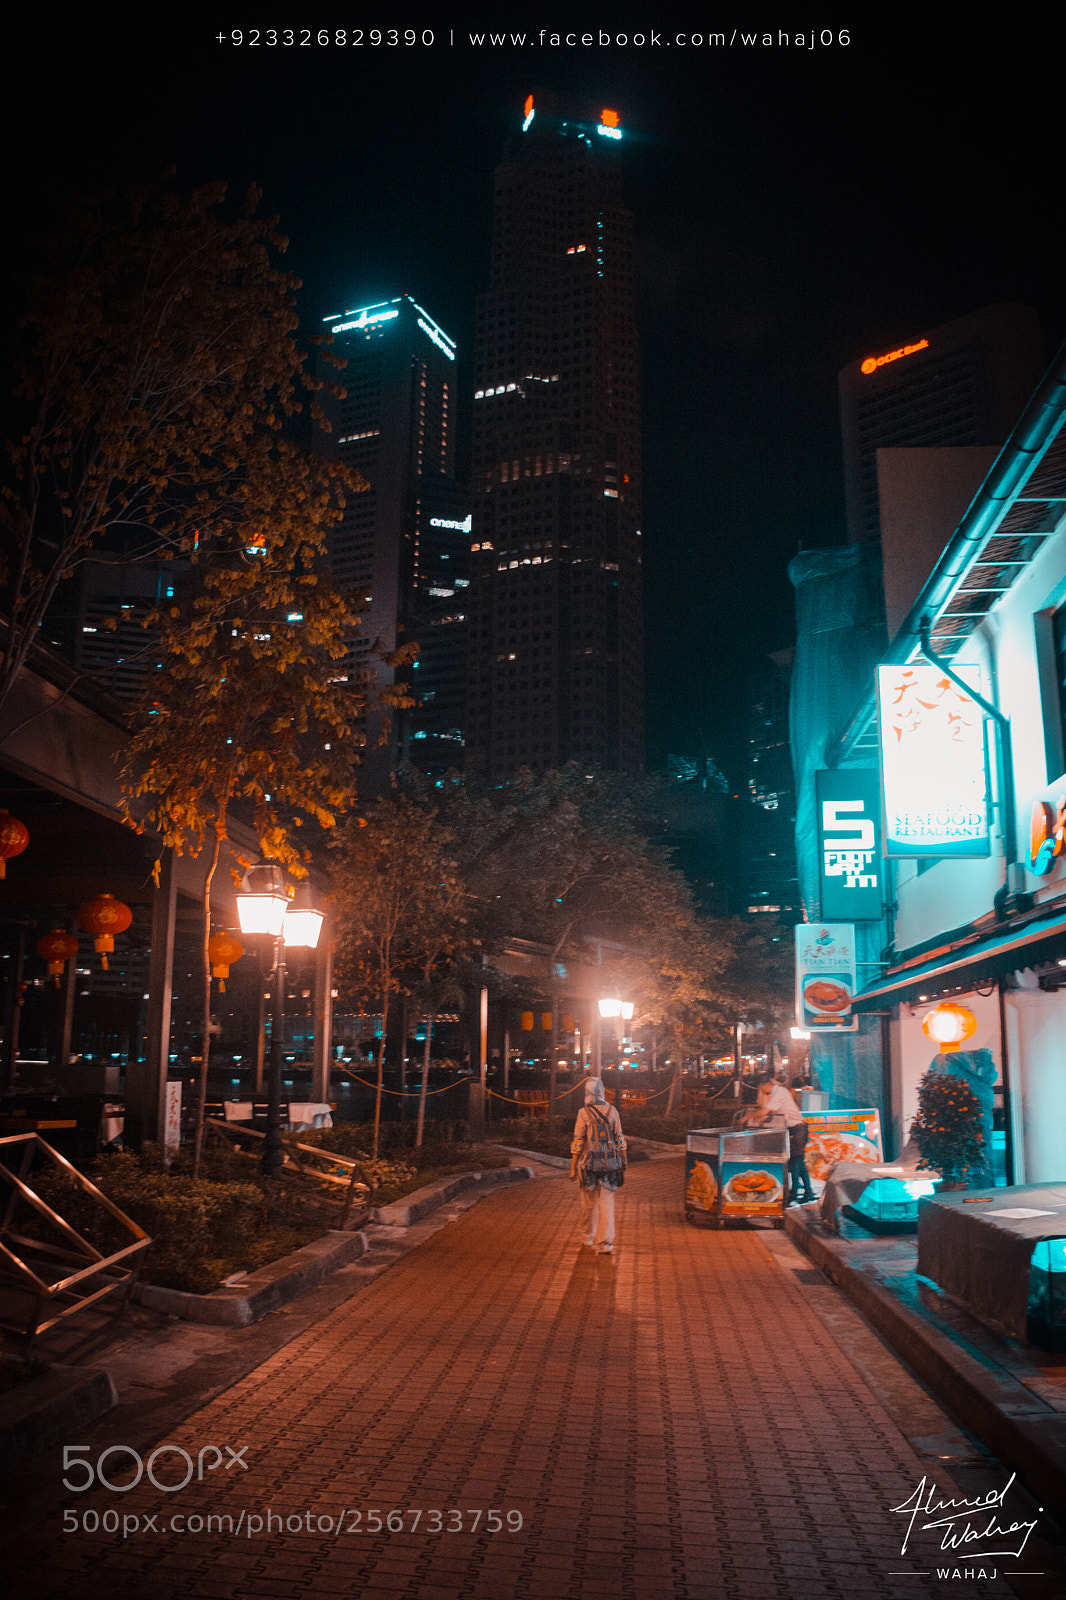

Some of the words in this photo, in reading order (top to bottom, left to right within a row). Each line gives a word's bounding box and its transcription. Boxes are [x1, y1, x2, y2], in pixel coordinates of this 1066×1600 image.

[822, 799, 875, 851] 5
[895, 813, 983, 826] SEAFOOD
[895, 826, 981, 837] RESTAURANT
